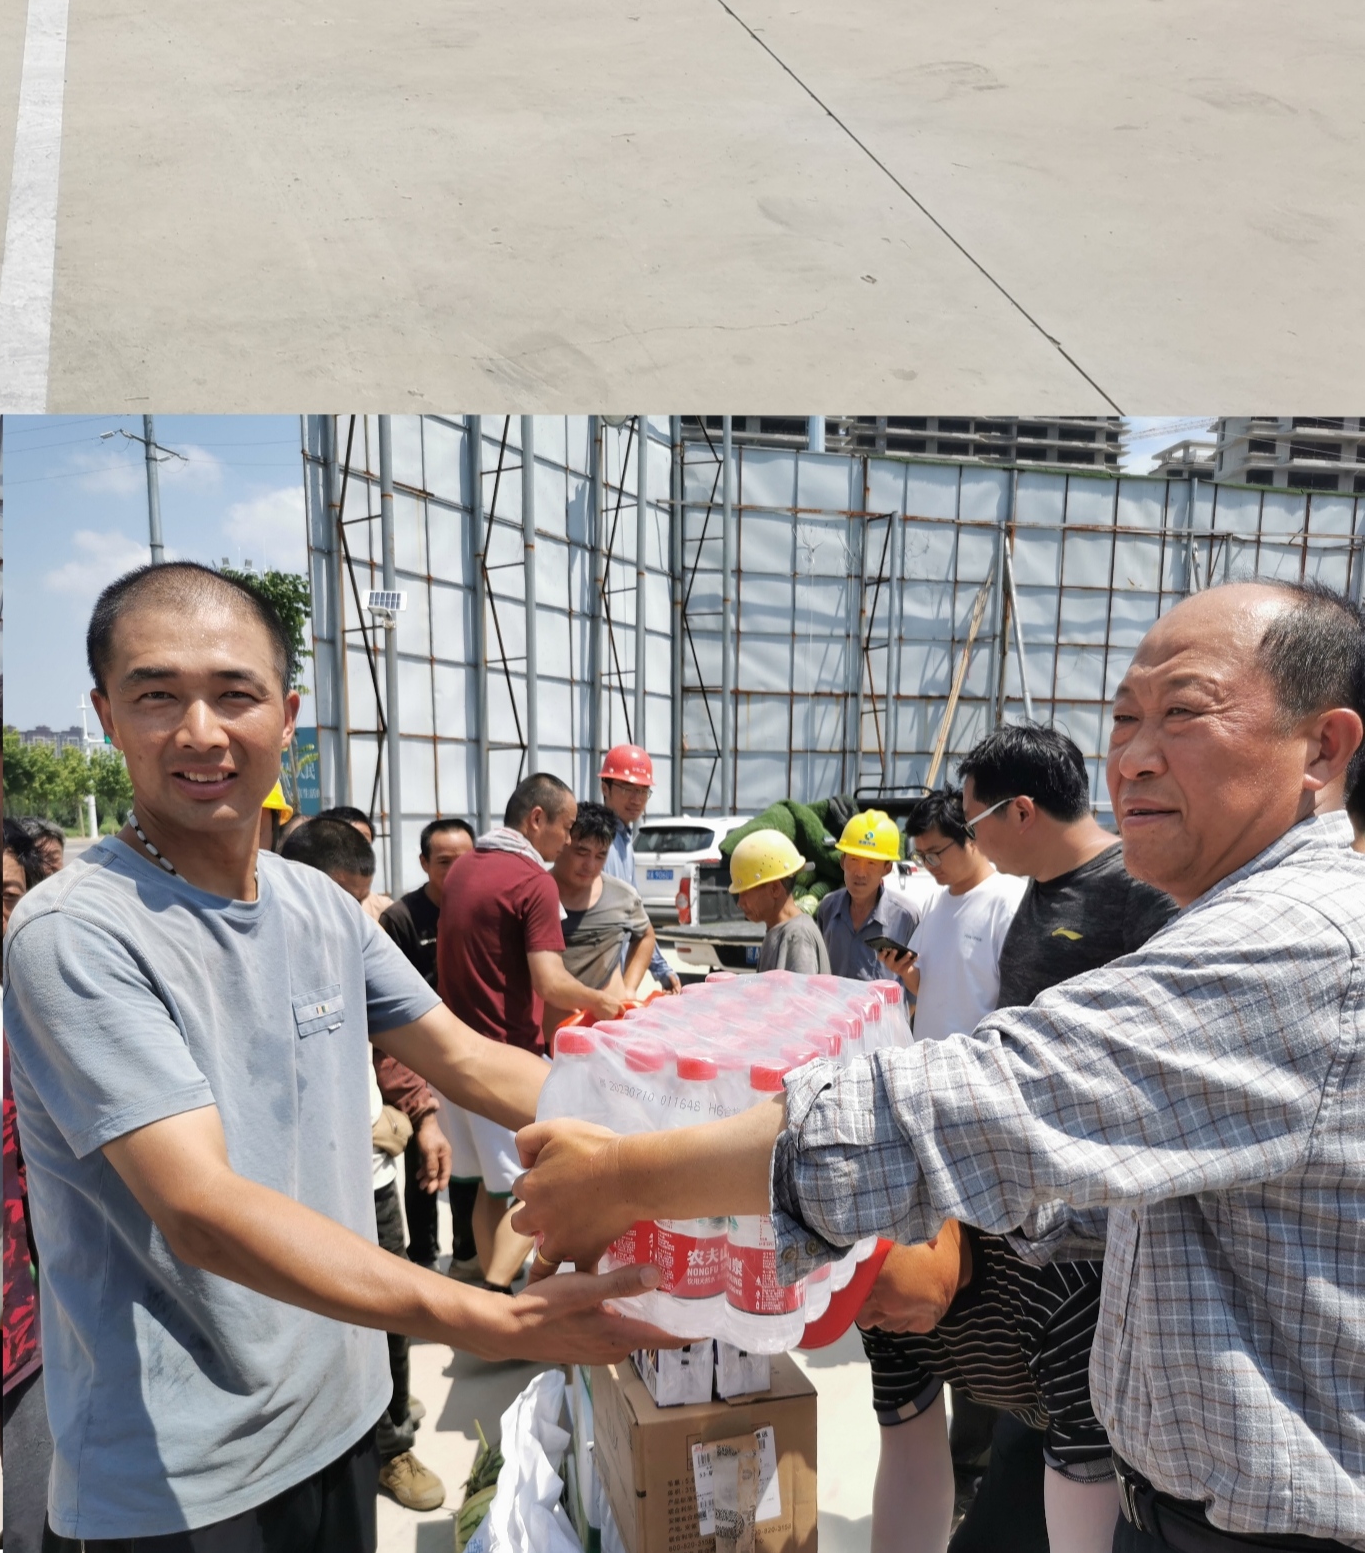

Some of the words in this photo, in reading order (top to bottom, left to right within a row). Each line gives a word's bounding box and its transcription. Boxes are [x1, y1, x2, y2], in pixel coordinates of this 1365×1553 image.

[608, 1079, 655, 1103] 20230710
[660, 1096, 702, 1113] 011648
[687, 1265, 719, 1277] NONGFU
